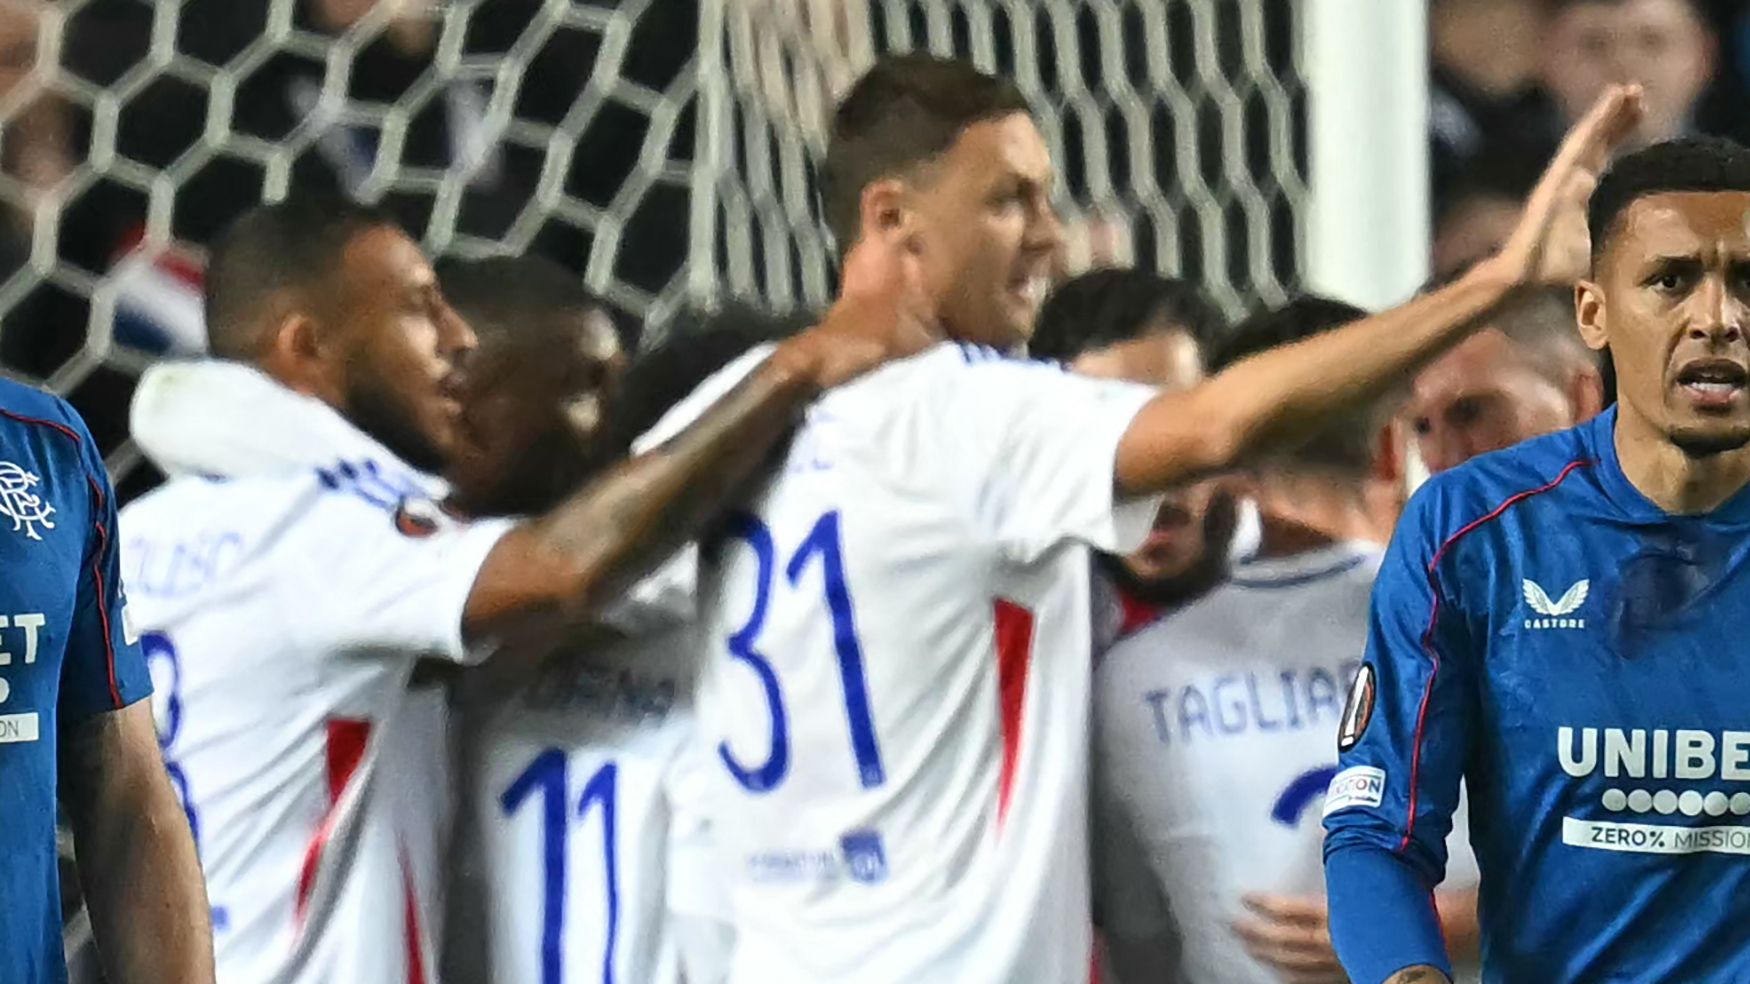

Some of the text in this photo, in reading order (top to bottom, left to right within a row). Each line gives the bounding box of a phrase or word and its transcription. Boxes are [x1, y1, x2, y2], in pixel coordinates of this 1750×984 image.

[1524, 618, 1585, 629] CASTORE
[717, 508, 886, 794] 31
[1590, 826, 1666, 849] ZERO%
